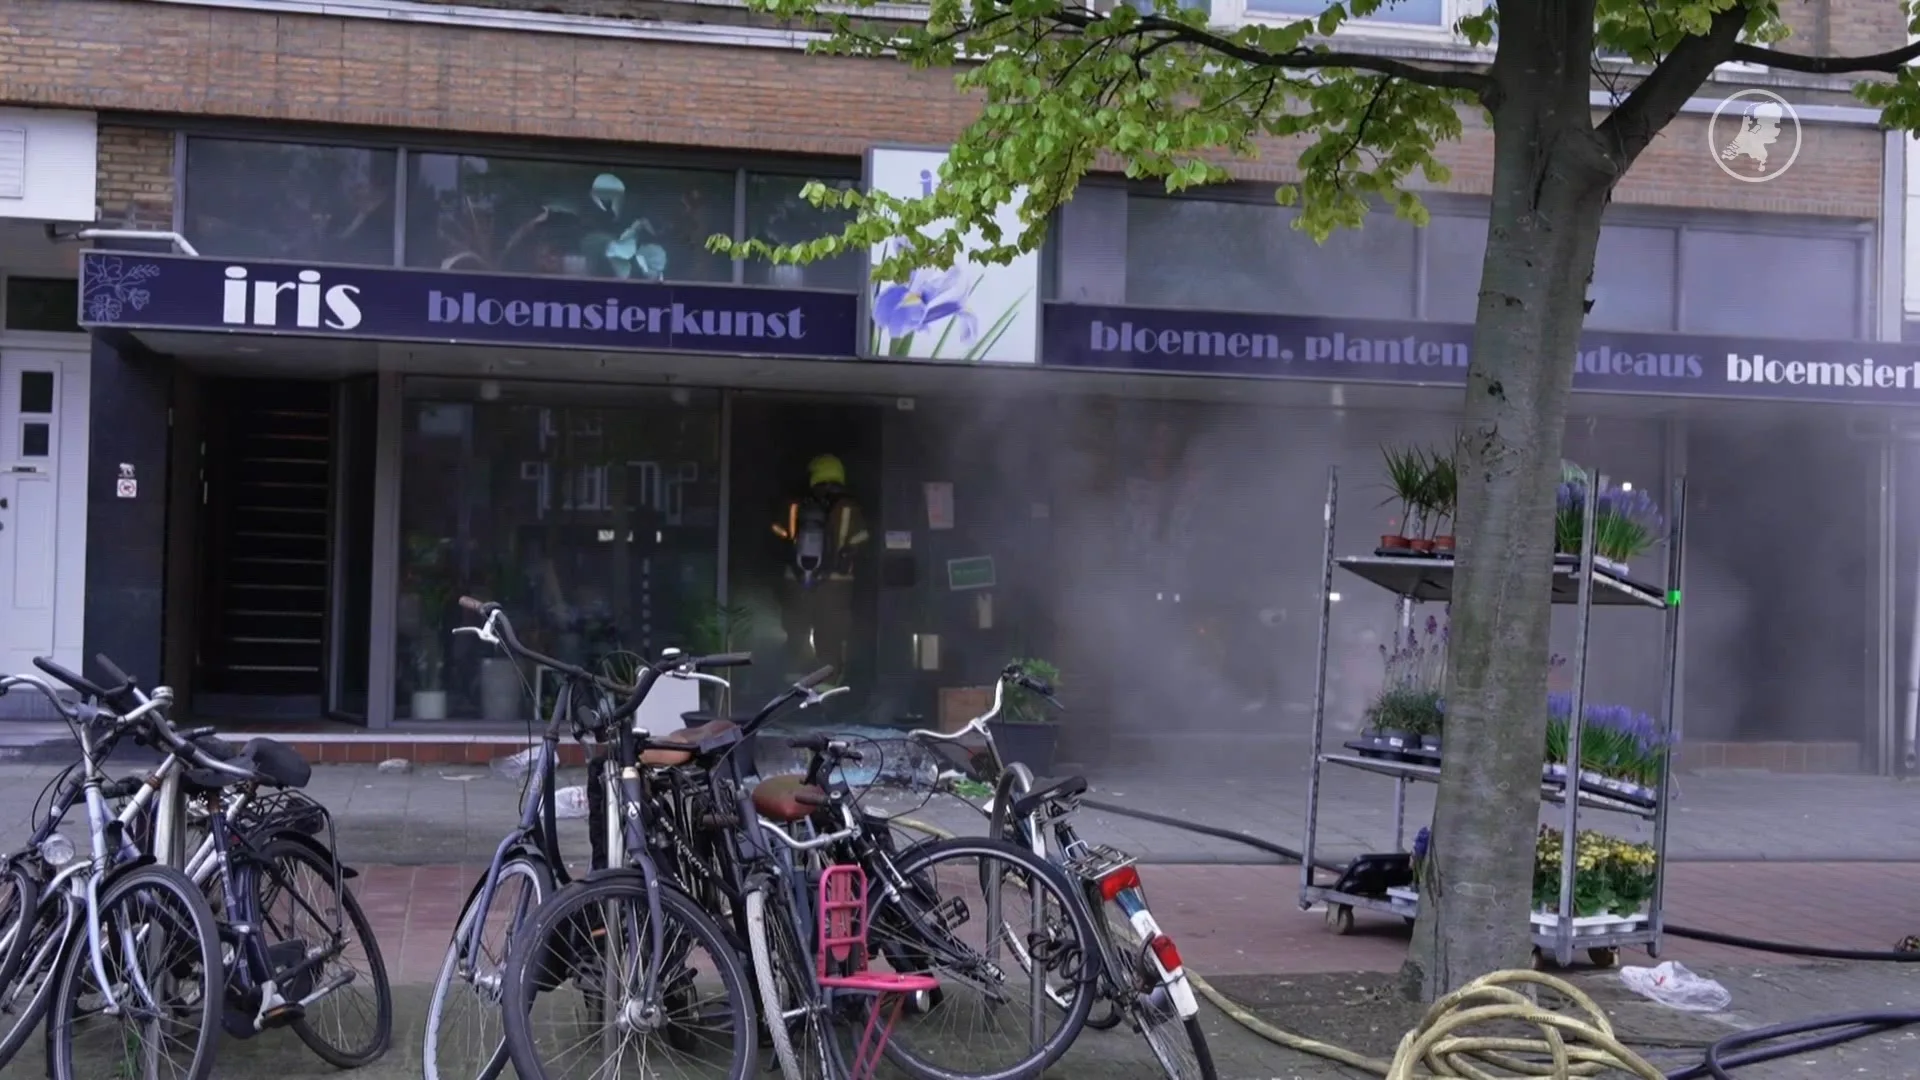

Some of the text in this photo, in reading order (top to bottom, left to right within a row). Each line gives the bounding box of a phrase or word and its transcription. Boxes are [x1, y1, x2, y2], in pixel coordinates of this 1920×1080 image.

[223, 266, 806, 339] iris bloemsierkunst
[1305, 332, 1468, 367] planten
